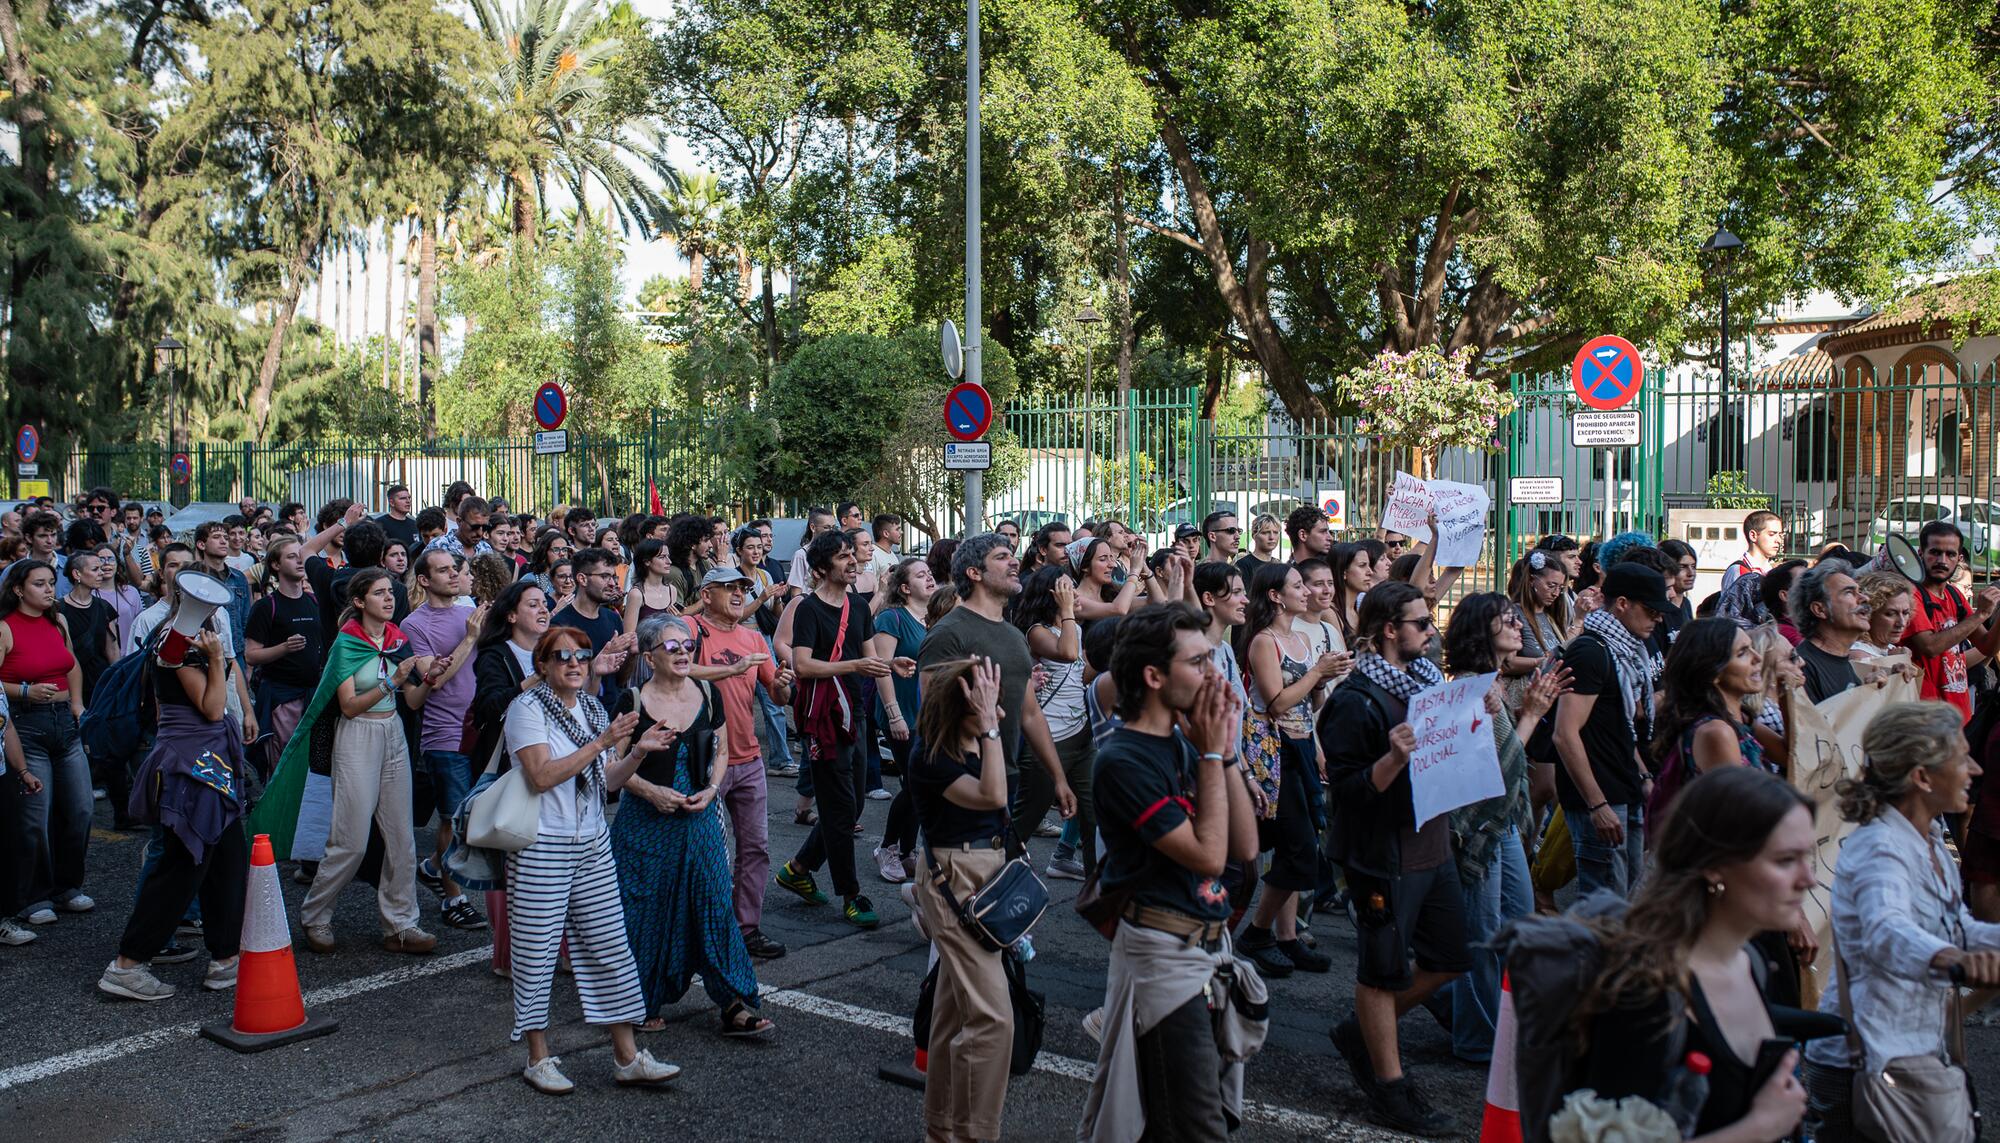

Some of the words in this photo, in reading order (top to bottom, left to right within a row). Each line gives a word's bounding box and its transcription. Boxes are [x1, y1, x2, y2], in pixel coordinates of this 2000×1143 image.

[1398, 475, 1427, 495] VIVA
[1395, 490, 1424, 508] LUCHA
[1414, 691, 1445, 720] BASTA
[1447, 684, 1465, 708] YA
[1415, 720, 1458, 750] EPRESIÓN
[1425, 716, 1439, 731] DE
[1413, 743, 1459, 776] POLICIAL
